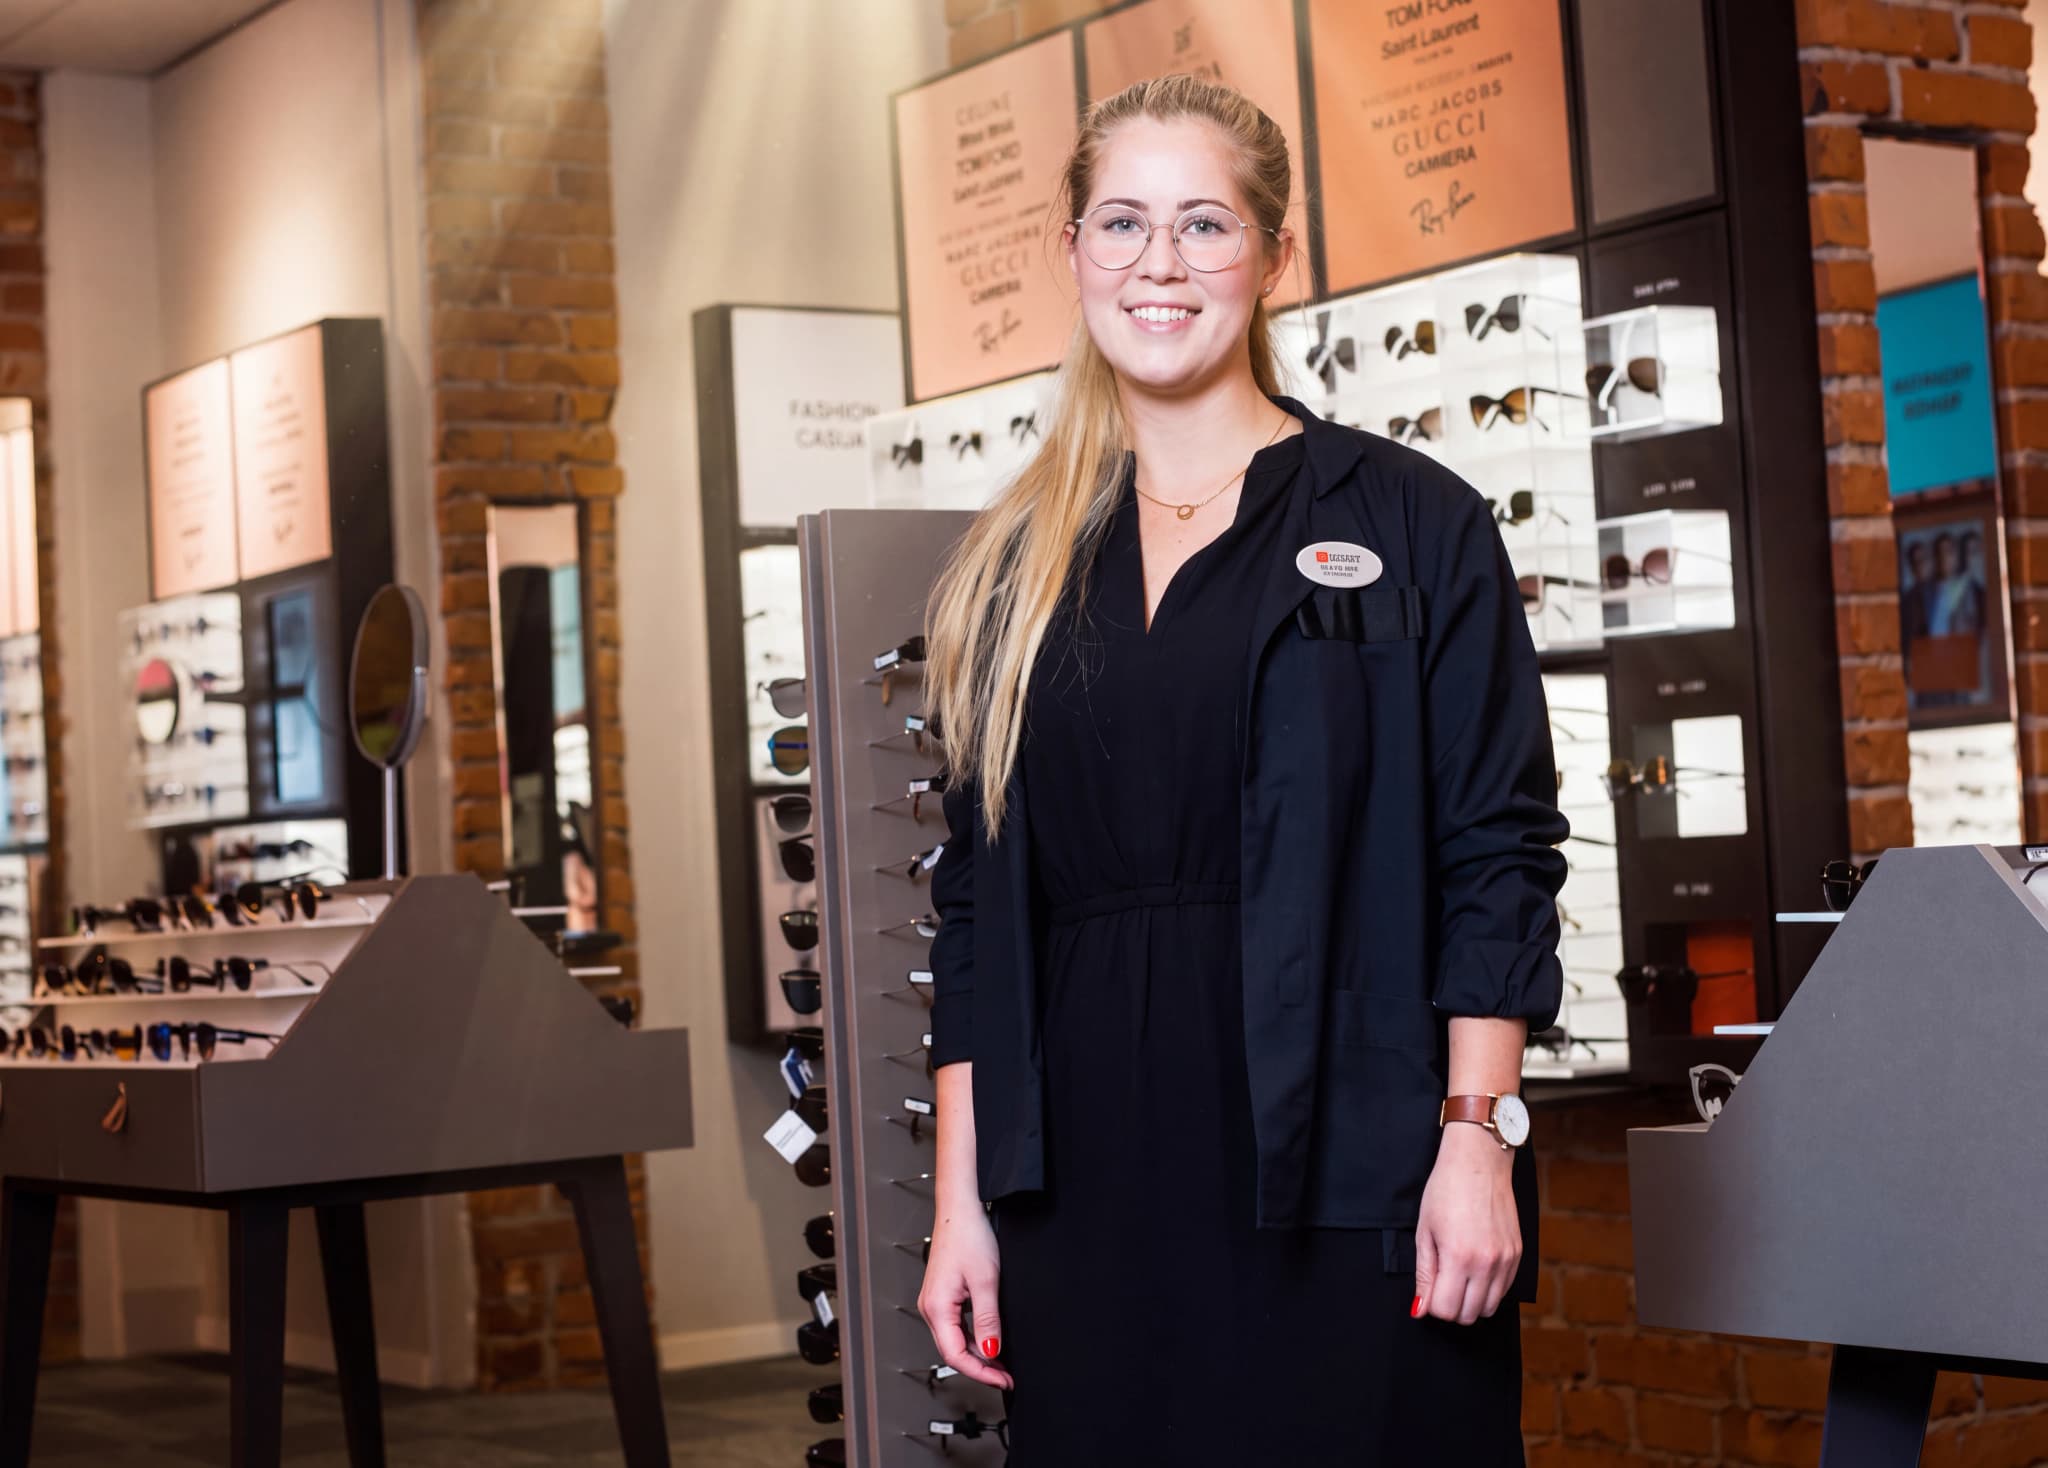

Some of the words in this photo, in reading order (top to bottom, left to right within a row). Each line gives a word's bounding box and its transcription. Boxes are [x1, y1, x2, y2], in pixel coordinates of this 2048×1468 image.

[1420, 13, 1480, 47] Laurent
[1371, 105, 1420, 130] MARC
[1429, 80, 1502, 115] JACOBS
[1393, 109, 1485, 156] GUCCI
[960, 248, 1029, 287] GUCCI
[789, 400, 880, 420] FASHION
[795, 427, 865, 450] CASUA
